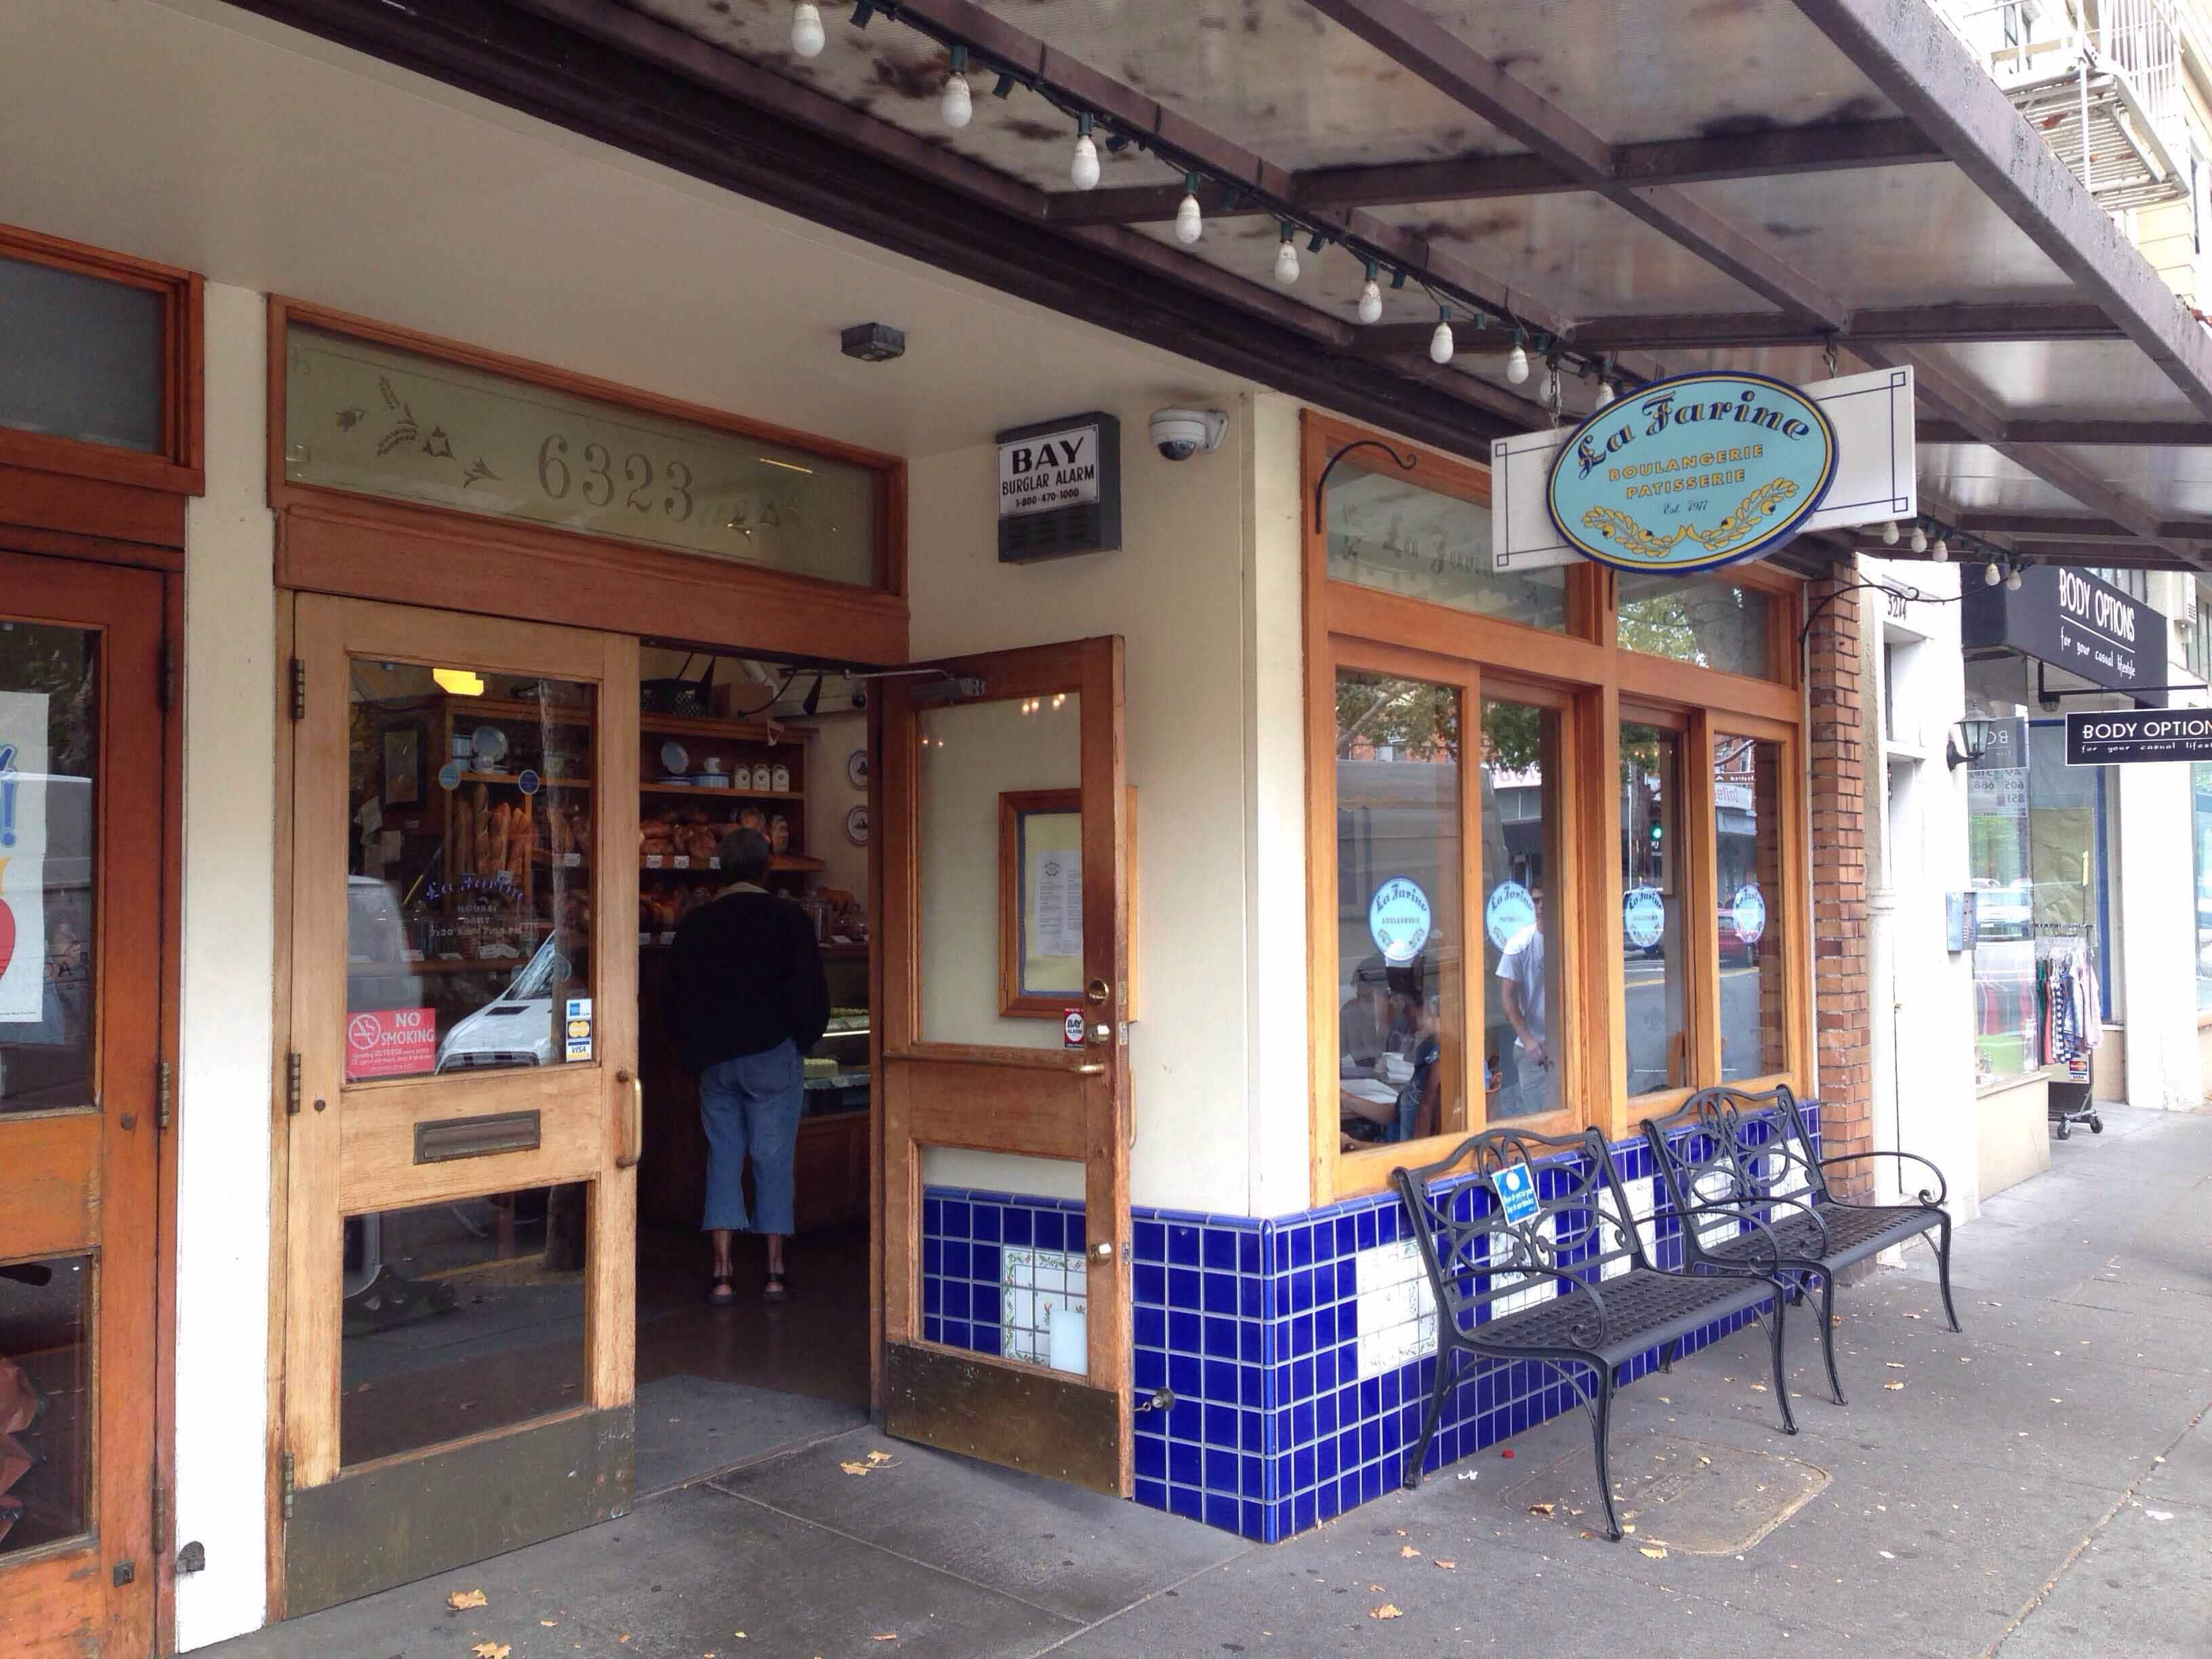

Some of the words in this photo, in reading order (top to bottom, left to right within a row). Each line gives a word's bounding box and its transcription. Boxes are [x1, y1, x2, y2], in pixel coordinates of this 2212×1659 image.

[1577, 424, 1637, 480] La
[1641, 389, 1810, 441] Farine
[1012, 436, 1084, 474] BAY
[1607, 443, 1763, 483] BOULANGERIE
[538, 433, 693, 523] 6323
[1002, 473, 1050, 495] BURGLAR
[1056, 464, 1094, 486] ALARM
[1626, 468, 1746, 500] PATISSERIE
[1662, 502, 1681, 516] Est.
[2059, 567, 2091, 619] BODY
[2095, 589, 2135, 642] OPTIONS
[2060, 626, 2071, 651] for
[2076, 641, 2091, 656] your
[2095, 650, 2114, 668] casual
[2116, 654, 2135, 680] lifestyle
[2082, 722, 2138, 739] BODY
[2081, 744, 2098, 754] for
[2107, 745, 2130, 754] your
[2139, 742, 2176, 750] casual
[1376, 893, 1390, 914] La
[1391, 882, 1428, 912] Farine
[394, 1011, 421, 1028] NO
[1067, 1019, 1083, 1028] BAY
[380, 1028, 434, 1046] SMOKING
[571, 1046, 586, 1054] VISA
